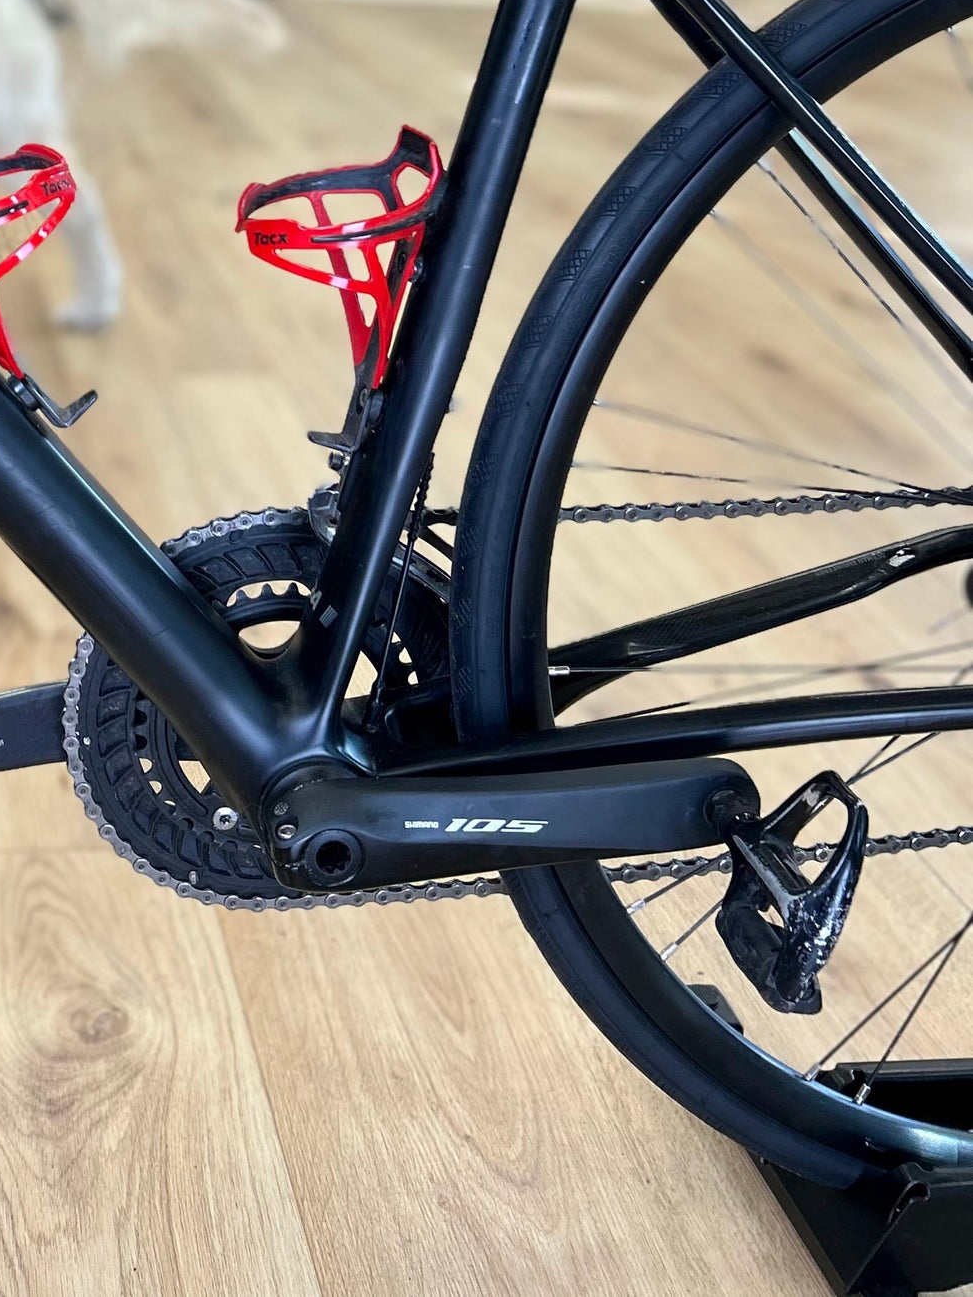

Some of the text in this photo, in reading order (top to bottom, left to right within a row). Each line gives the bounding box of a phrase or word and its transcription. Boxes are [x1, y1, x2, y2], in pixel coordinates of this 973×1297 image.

[254, 231, 288, 245] Tacx
[404, 818, 549, 833] SHIMANO 105
